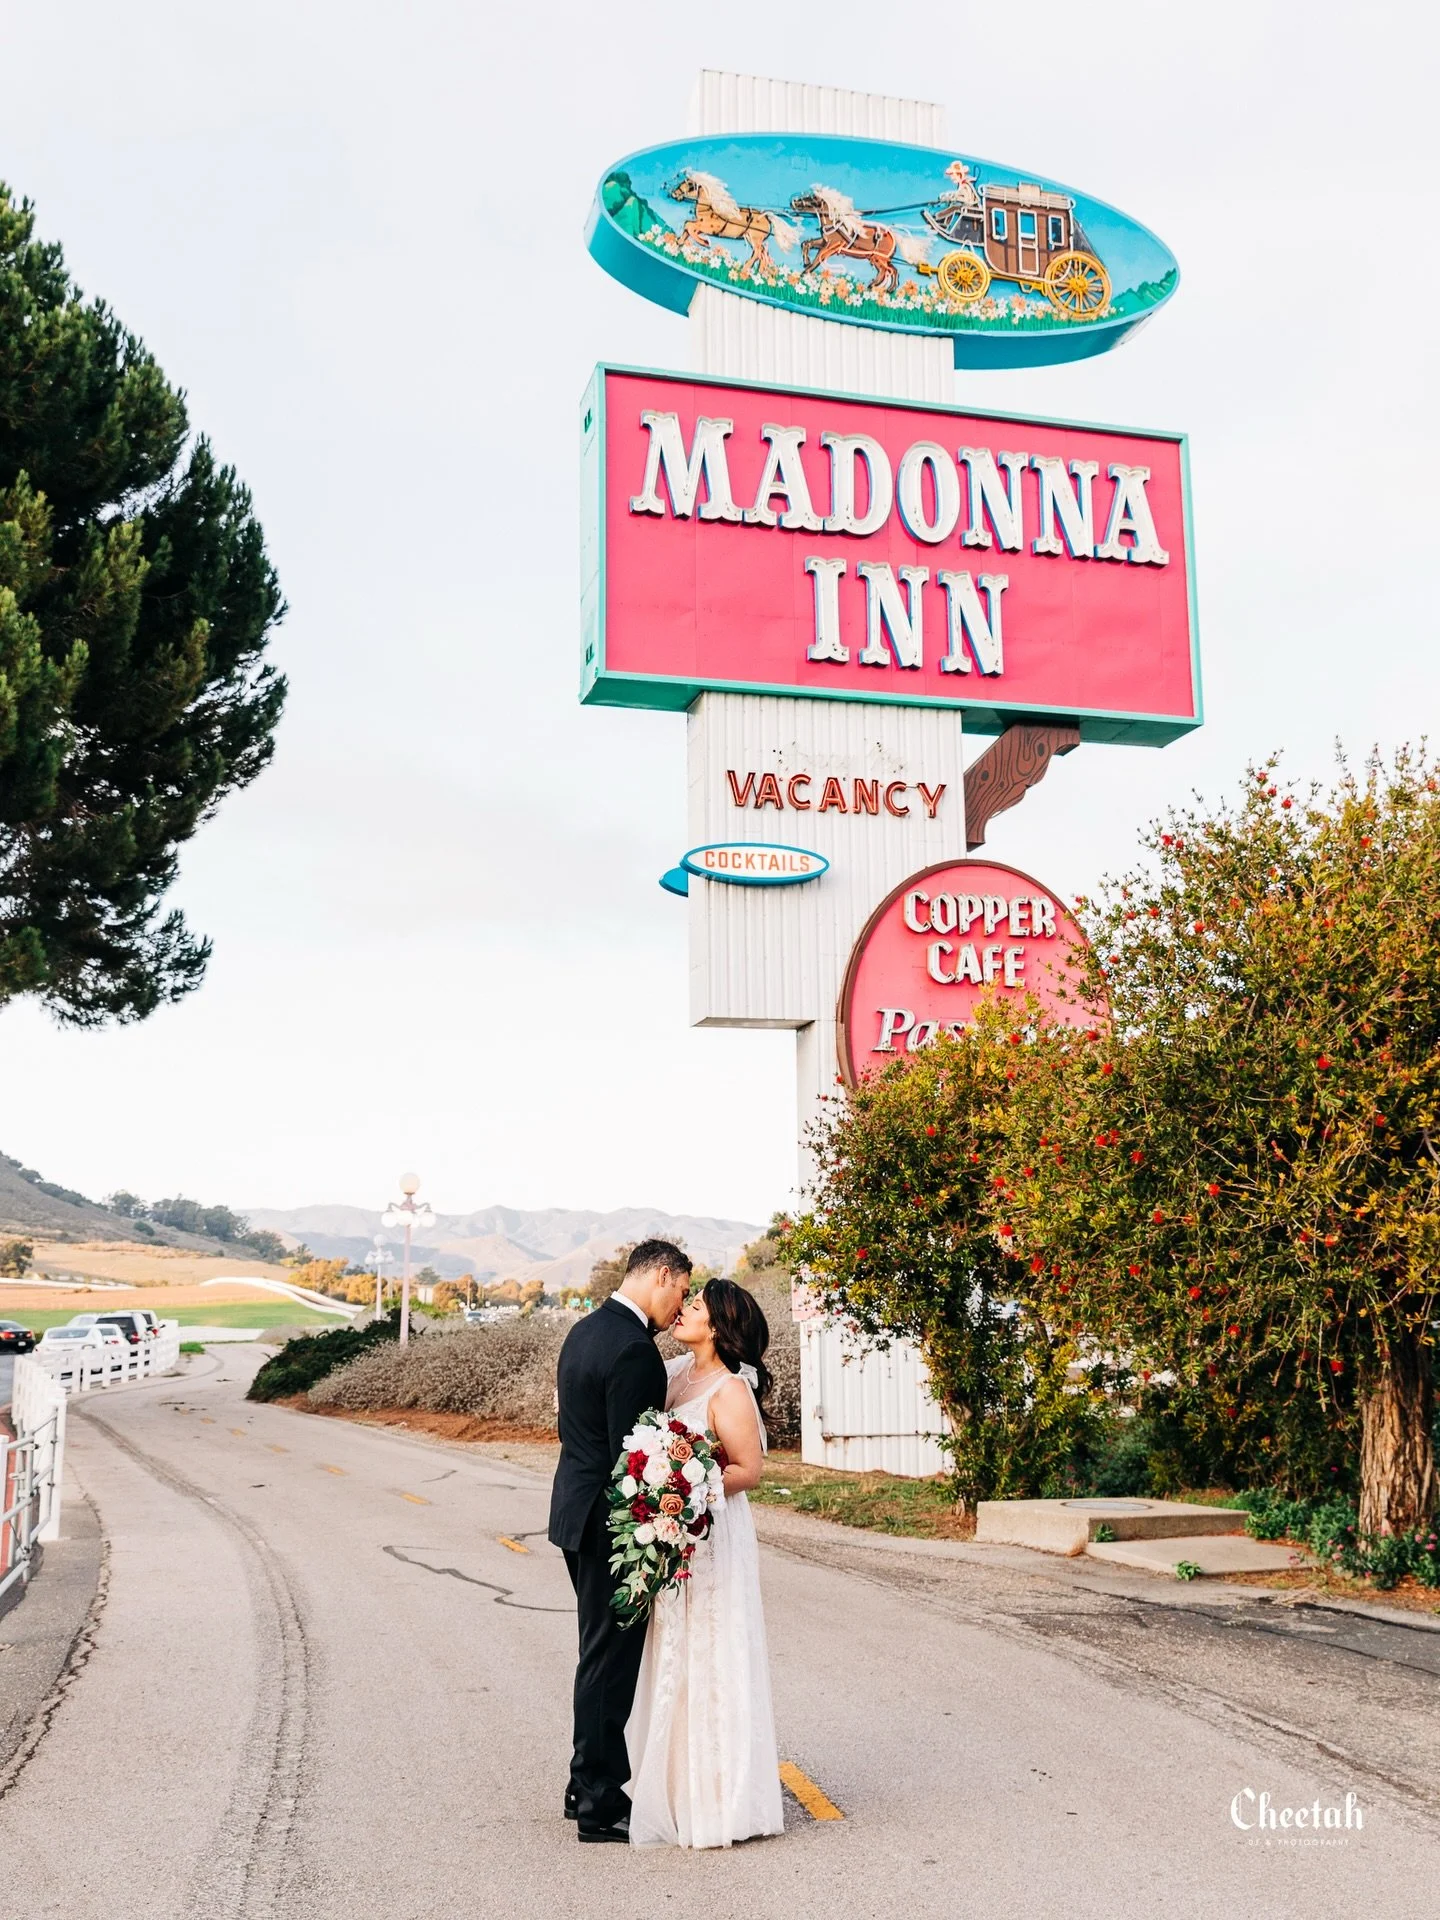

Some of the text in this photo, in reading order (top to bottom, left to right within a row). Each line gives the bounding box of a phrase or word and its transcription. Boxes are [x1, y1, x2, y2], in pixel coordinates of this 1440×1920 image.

[630, 411, 1169, 566] MADONNA
[805, 557, 1009, 675] INN
[727, 770, 946, 817] VACANCY
[705, 851, 810, 872] COCKTAILS
[904, 890, 1057, 937] COPPER
[927, 940, 1026, 987] CAFE
